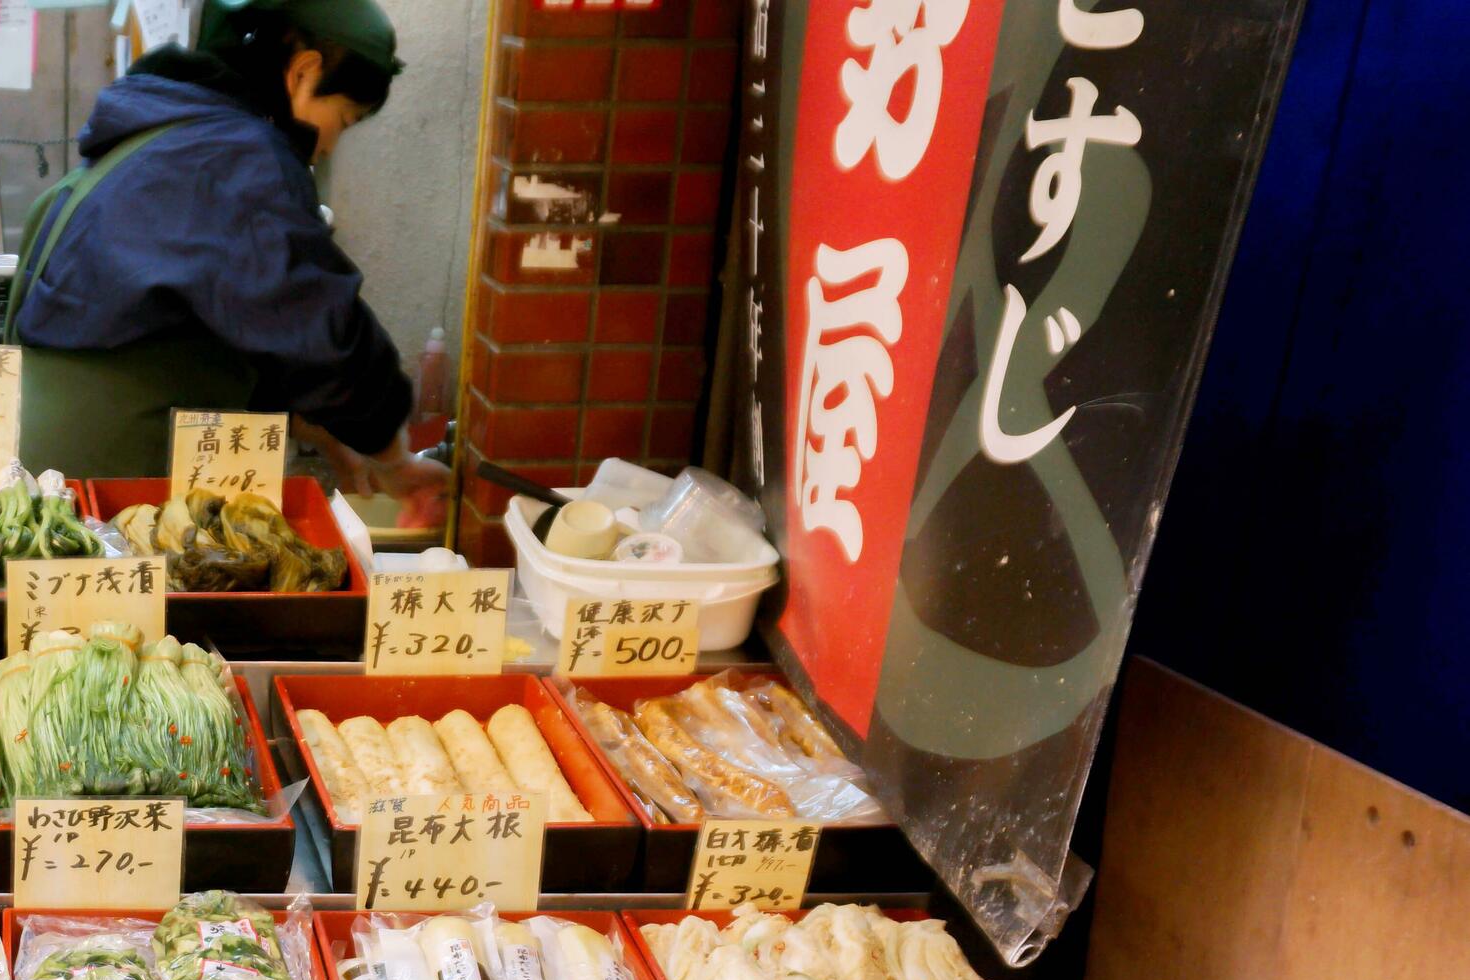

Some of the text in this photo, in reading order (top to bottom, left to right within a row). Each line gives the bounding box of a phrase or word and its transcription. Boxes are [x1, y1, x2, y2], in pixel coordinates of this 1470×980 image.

[197, 424, 284, 454] 高菜漬
[28, 802, 172, 832] わさび野沢菜
[437, 794, 530, 813] 人気商品
[388, 811, 523, 845] 昆布大根
